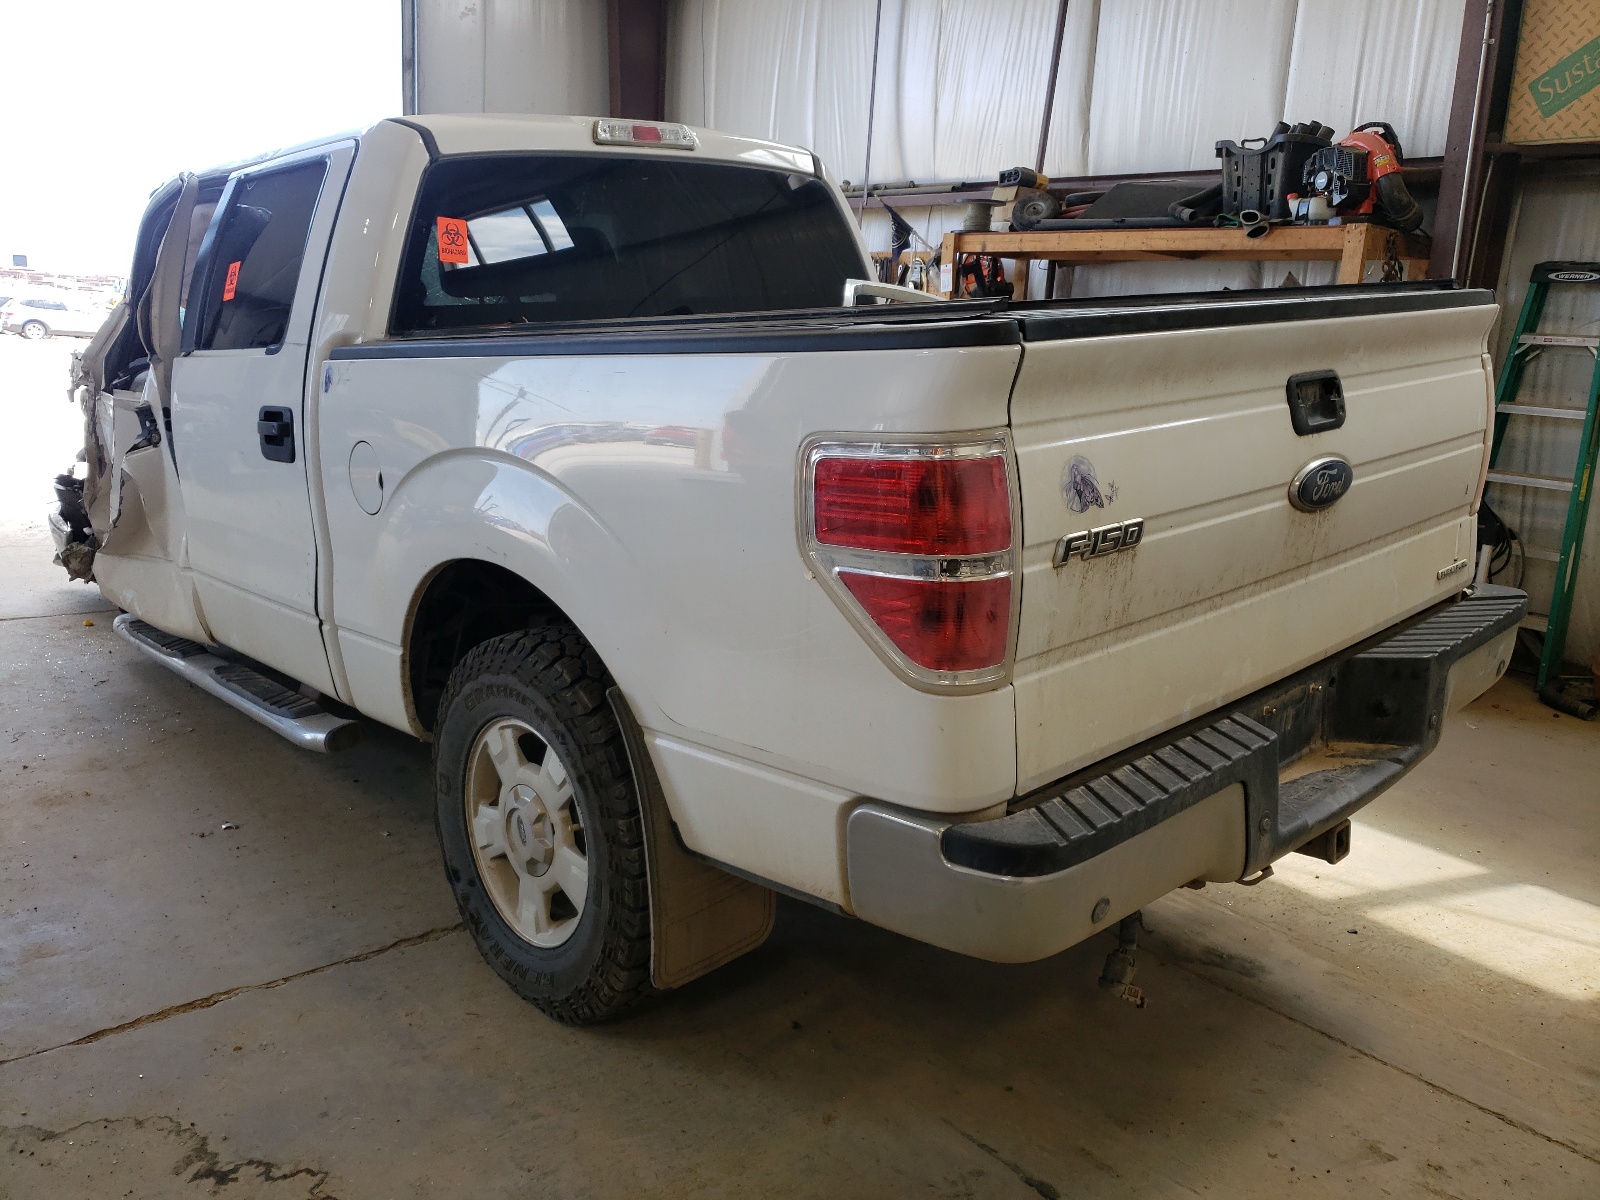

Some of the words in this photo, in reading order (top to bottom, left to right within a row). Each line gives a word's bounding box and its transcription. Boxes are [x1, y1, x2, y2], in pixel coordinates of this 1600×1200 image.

[441, 247, 467, 256] BIOHAZARD
[1312, 467, 1345, 501] Ford
[1052, 517, 1144, 568] F-150
